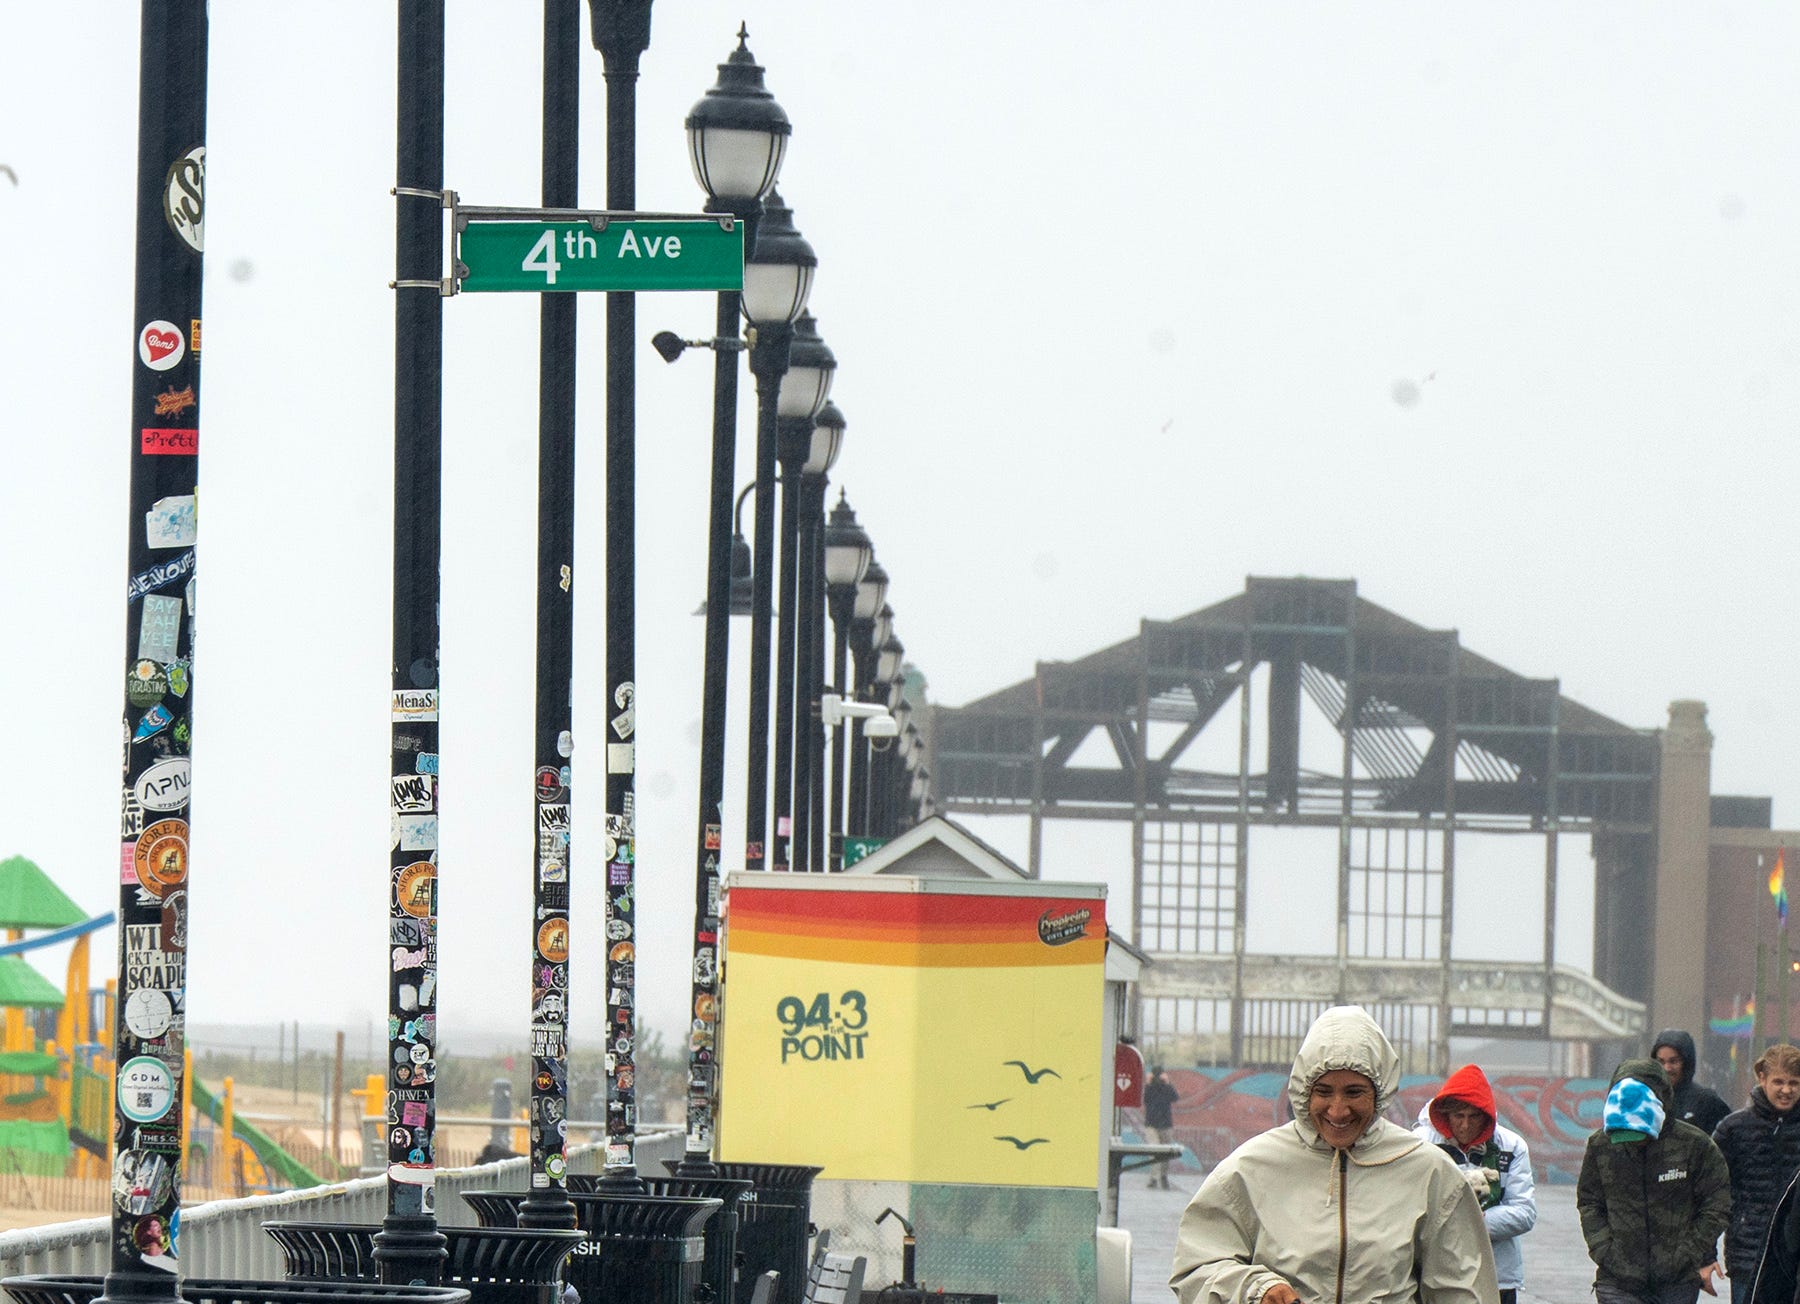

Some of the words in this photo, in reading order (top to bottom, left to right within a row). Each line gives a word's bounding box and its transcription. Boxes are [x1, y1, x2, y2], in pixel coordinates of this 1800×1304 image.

[522, 229, 597, 284] 4th
[617, 229, 682, 259] Ave
[144, 599, 176, 613] SAY
[138, 822, 172, 861] SHORE
[781, 1031, 869, 1065] POINT
[737, 1192, 757, 1202] SH
